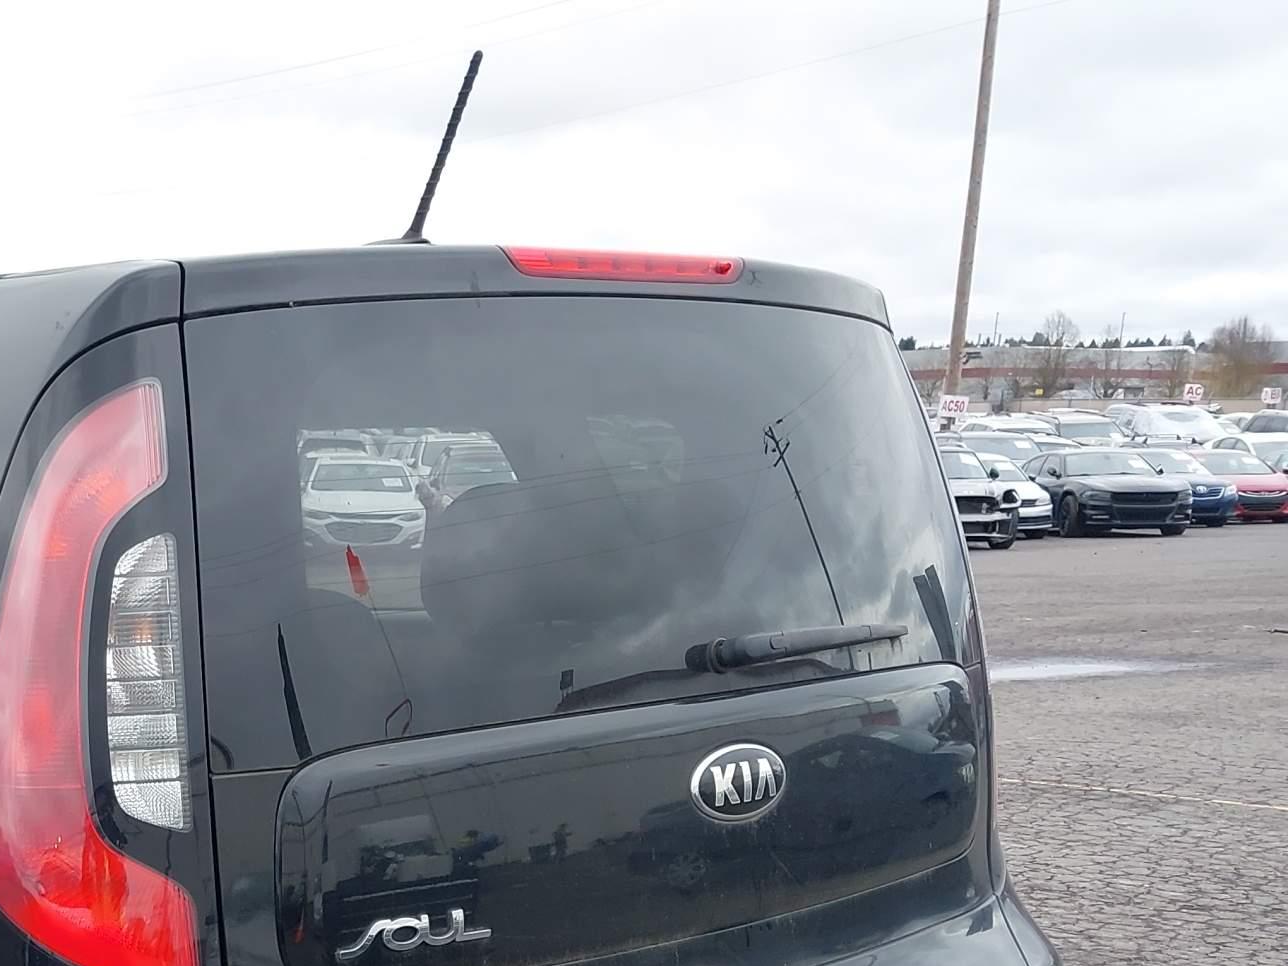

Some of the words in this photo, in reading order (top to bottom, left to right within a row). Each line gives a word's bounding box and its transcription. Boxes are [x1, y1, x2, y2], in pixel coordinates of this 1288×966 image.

[940, 400, 965, 412] AC50
[710, 758, 777, 807] KIA
[335, 908, 492, 960] SOUL
